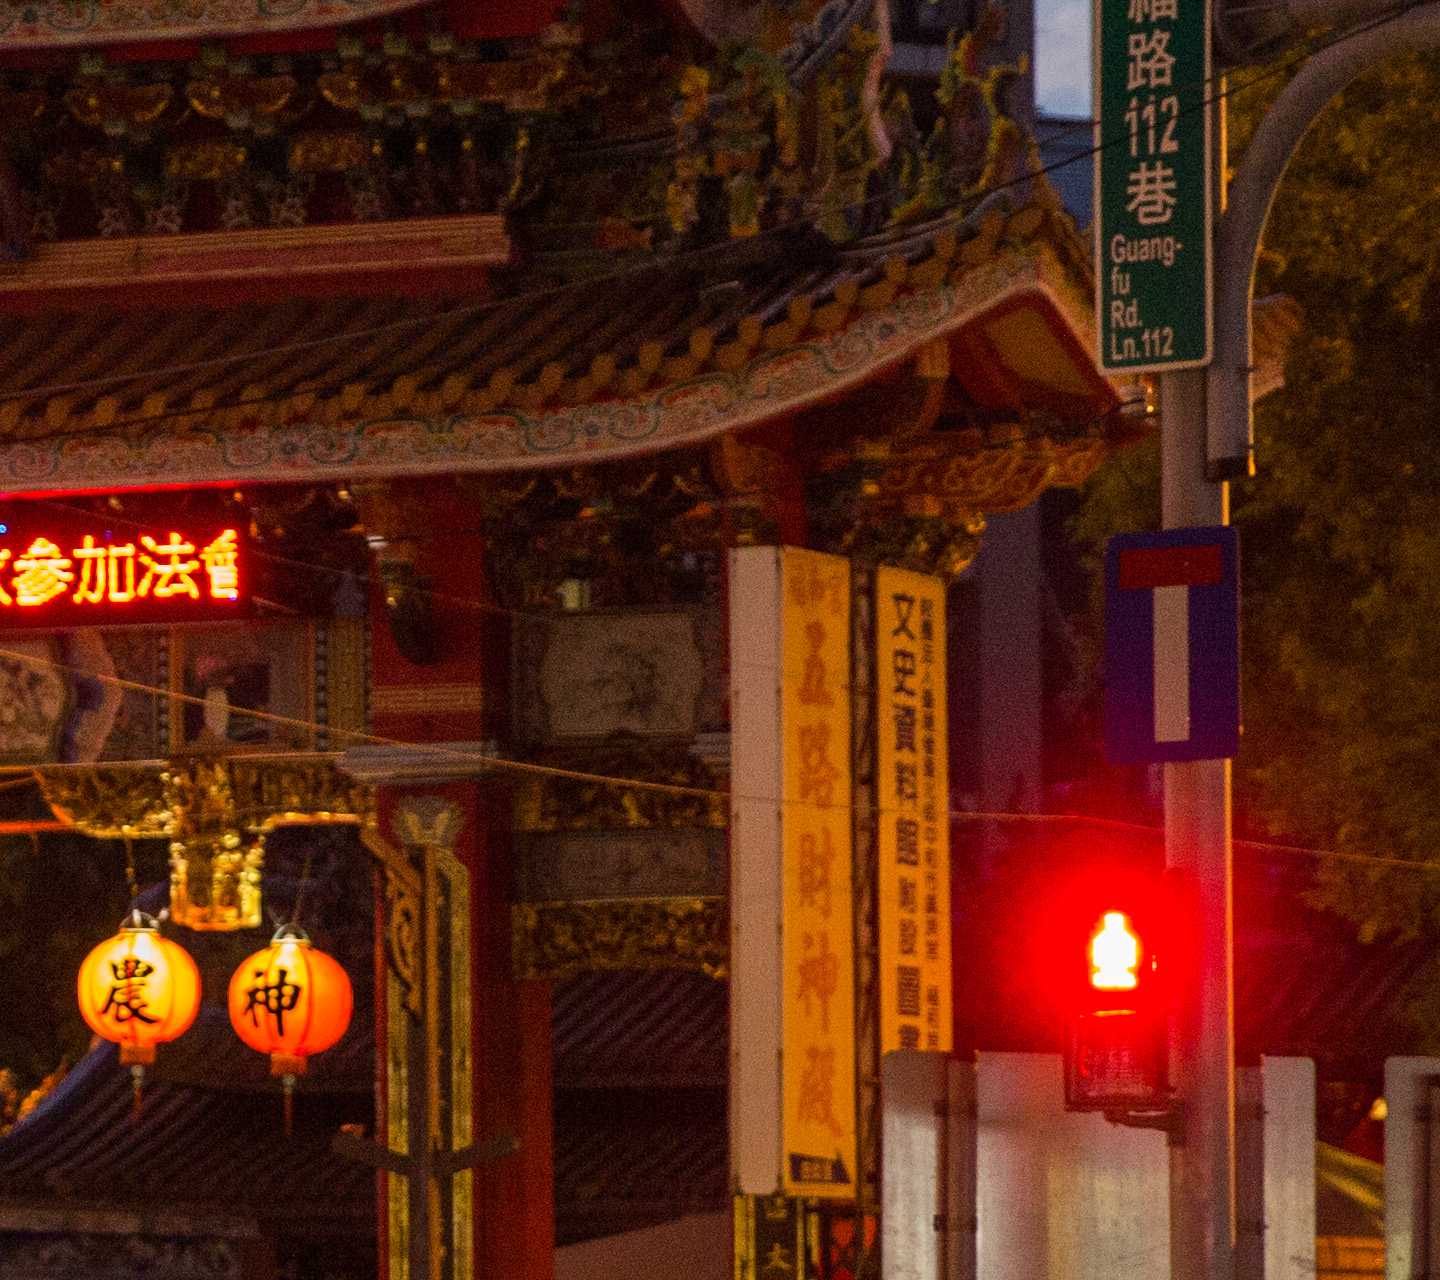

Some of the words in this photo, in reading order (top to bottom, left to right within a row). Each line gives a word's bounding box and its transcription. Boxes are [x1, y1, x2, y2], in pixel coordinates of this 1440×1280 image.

[1110, 232, 1182, 266] Guang-
[1111, 263, 1131, 296] fu
[1110, 299, 1144, 329] Rd.
[1110, 326, 1175, 363] Ln.112
[97, 957, 161, 1026] 農
[244, 966, 302, 1039] 神
